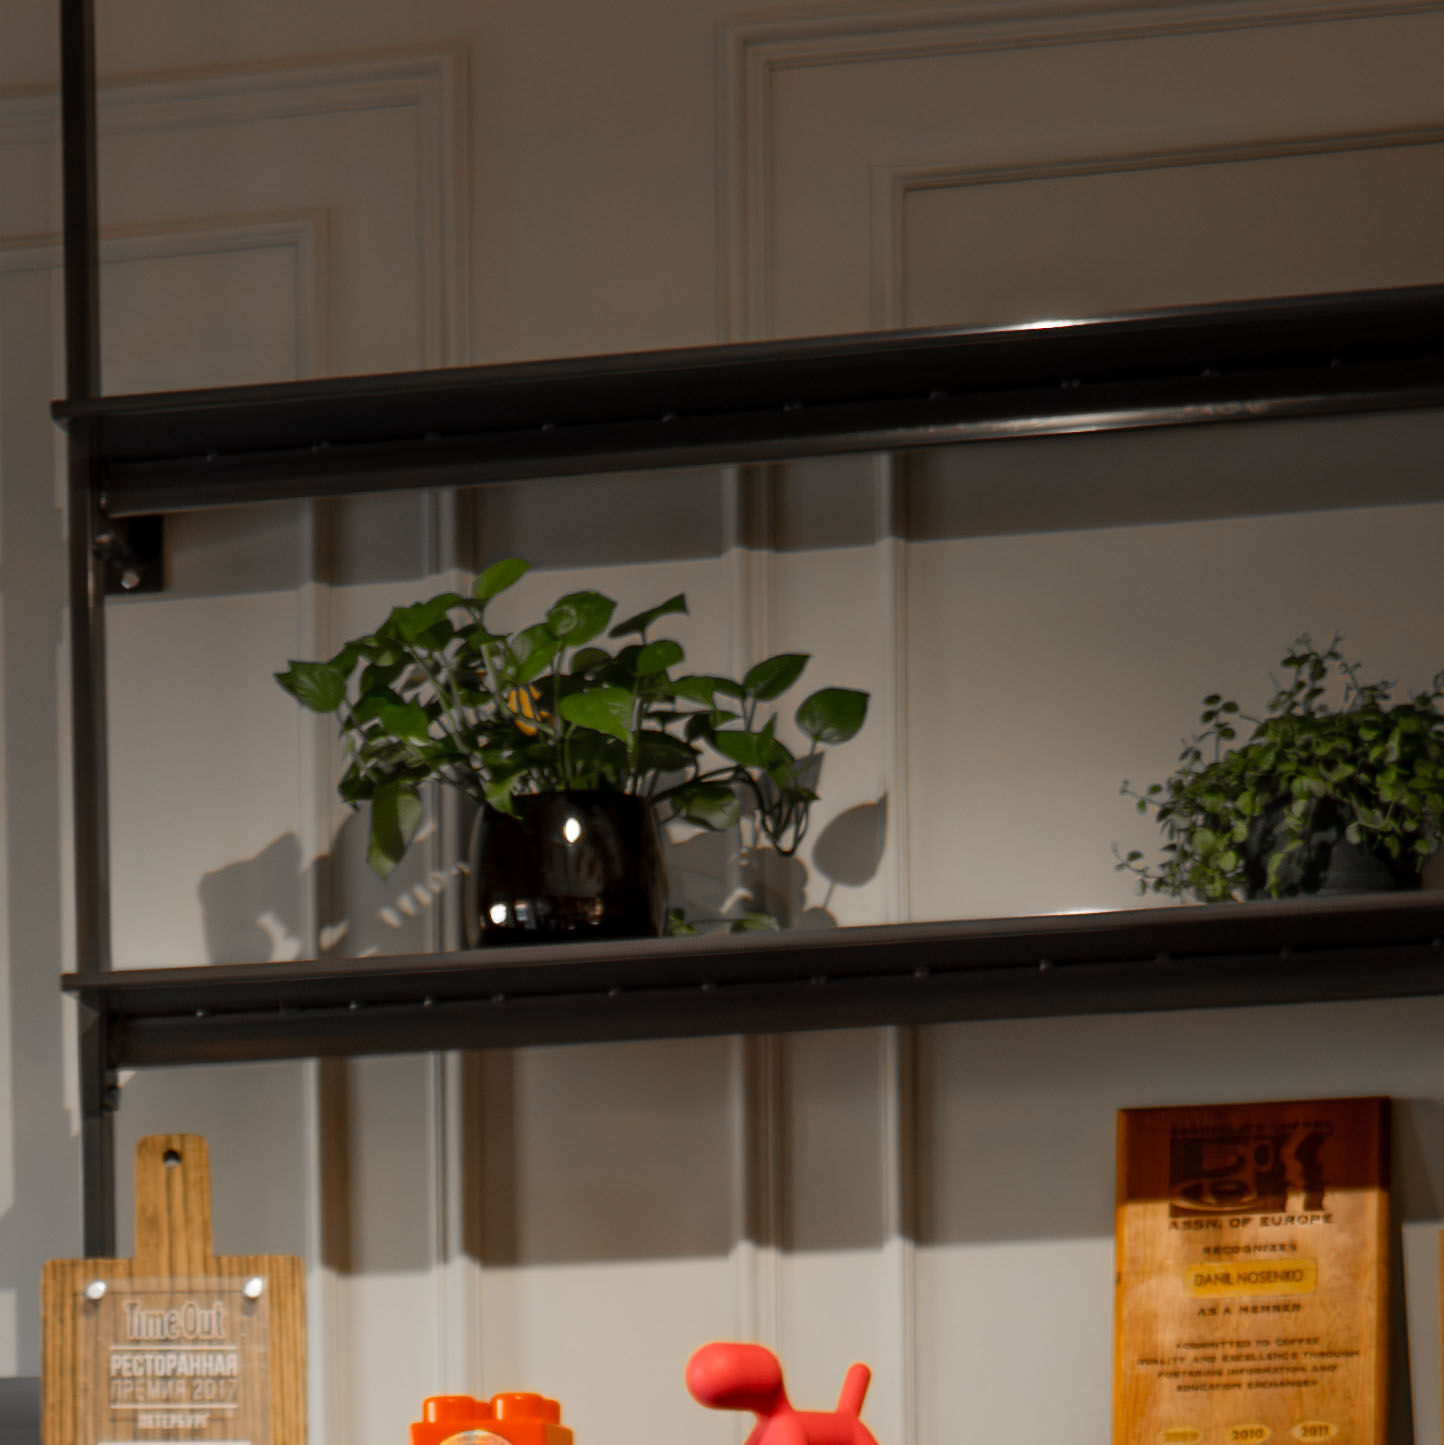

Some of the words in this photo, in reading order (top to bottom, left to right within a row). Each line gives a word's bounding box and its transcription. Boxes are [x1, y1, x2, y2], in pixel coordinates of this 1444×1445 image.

[1229, 1217, 1252, 1229] OF
[1259, 1213, 1334, 1227] EUROPE
[1236, 1268, 1304, 1285] NOSENKO
[123, 1300, 181, 1341] Time
[182, 1300, 225, 1340] Out
[110, 1353, 238, 1376] РЕСТОРАННАЯ
[110, 1378, 187, 1401] ПРЕМИЯ
[191, 1378, 238, 1401] 2017
[1231, 1427, 1264, 1441] 2010
